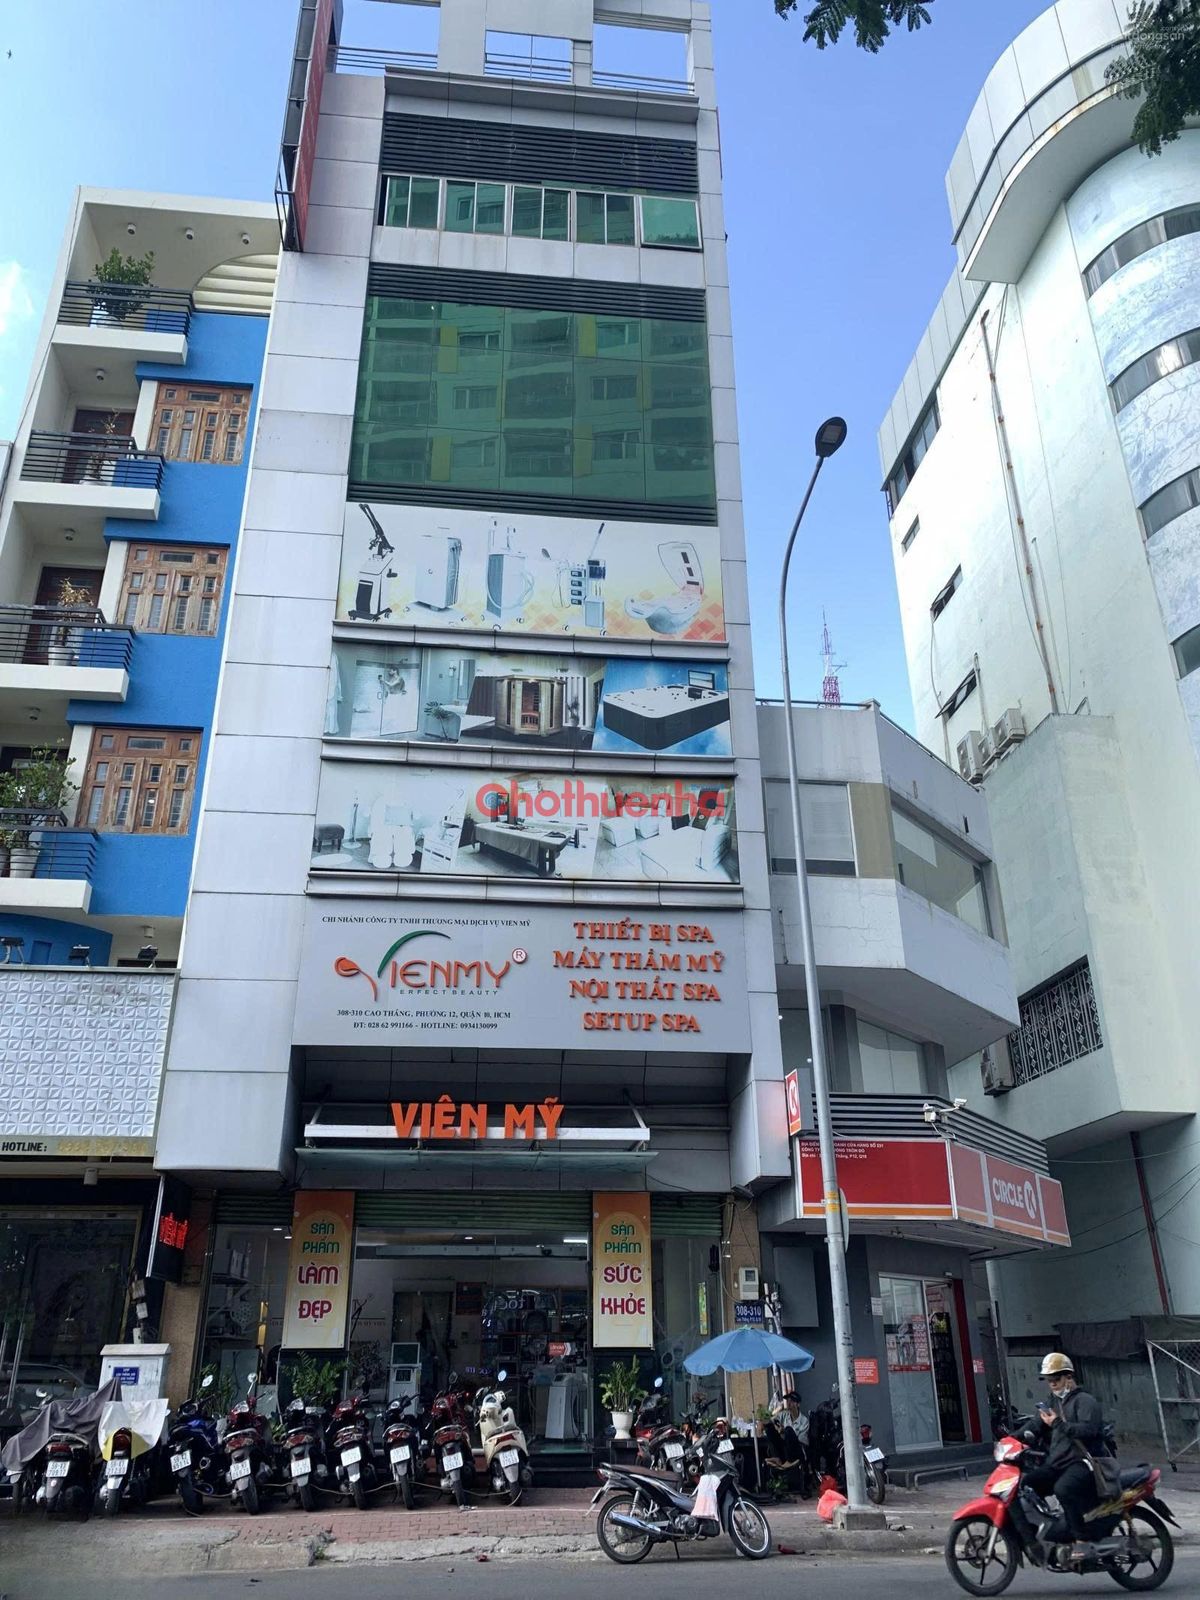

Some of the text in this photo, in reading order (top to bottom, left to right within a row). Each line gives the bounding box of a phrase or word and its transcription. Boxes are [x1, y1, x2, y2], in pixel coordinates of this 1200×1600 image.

[366, 915, 387, 924] CÔNG
[573, 917, 714, 946] THIẾT BỊ SPA
[553, 946, 604, 969] MÁY
[687, 951, 725, 973] MỸ
[569, 976, 721, 1004] NỘI THẤT SPA
[583, 1012, 700, 1032] SETUP SPA
[391, 1094, 565, 1140] VIÊN MỸ
[2, 1142, 47, 1152] HOTLINE:
[992, 1178, 1024, 1208] CIRCLE
[310, 1219, 335, 1235] SẢN
[611, 1221, 635, 1236] SẢN
[302, 1236, 340, 1254] PHẨM
[604, 1237, 642, 1254] PHẨM
[298, 1261, 339, 1285] LÀM
[603, 1263, 642, 1284] SỨC
[298, 1300, 333, 1323] ĐẸP
[601, 1292, 646, 1315] KHỎE
[736, 1305, 761, 1316] 308-310
